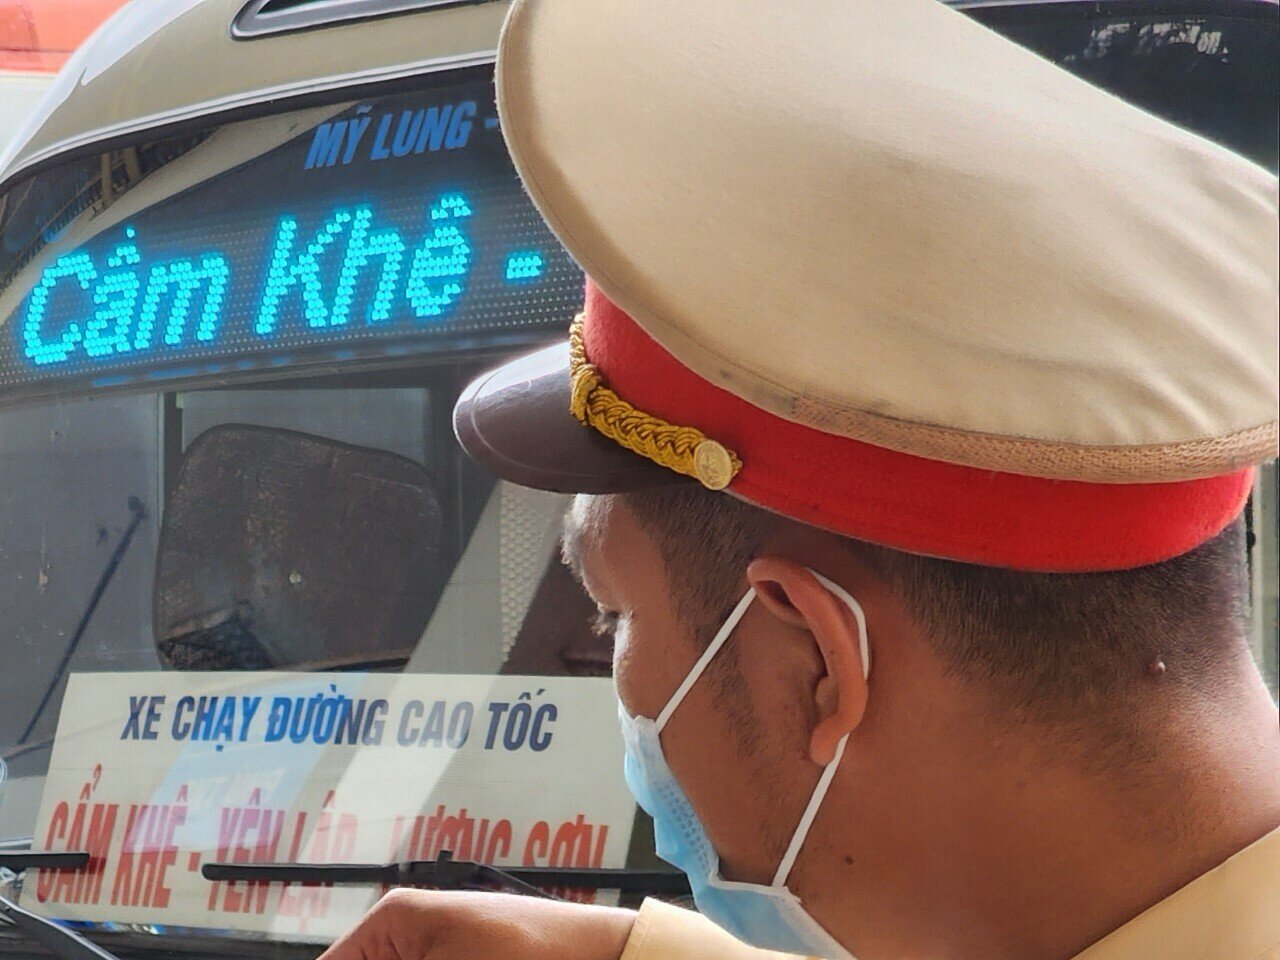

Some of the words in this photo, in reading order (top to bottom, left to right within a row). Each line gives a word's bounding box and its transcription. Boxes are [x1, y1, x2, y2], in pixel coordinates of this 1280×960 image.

[305, 106, 363, 169] MỸ
[371, 101, 477, 160] LUNG
[254, 196, 471, 334] Khê
[120, 695, 165, 741] XE
[172, 695, 255, 753] CHẠY
[264, 683, 385, 747] ĐƯỜNG
[396, 701, 473, 750] CAO
[484, 689, 558, 752] TỐC
[36, 763, 119, 905] CẨM
[111, 784, 189, 909] KHÊ
[207, 787, 286, 915] YÊN
